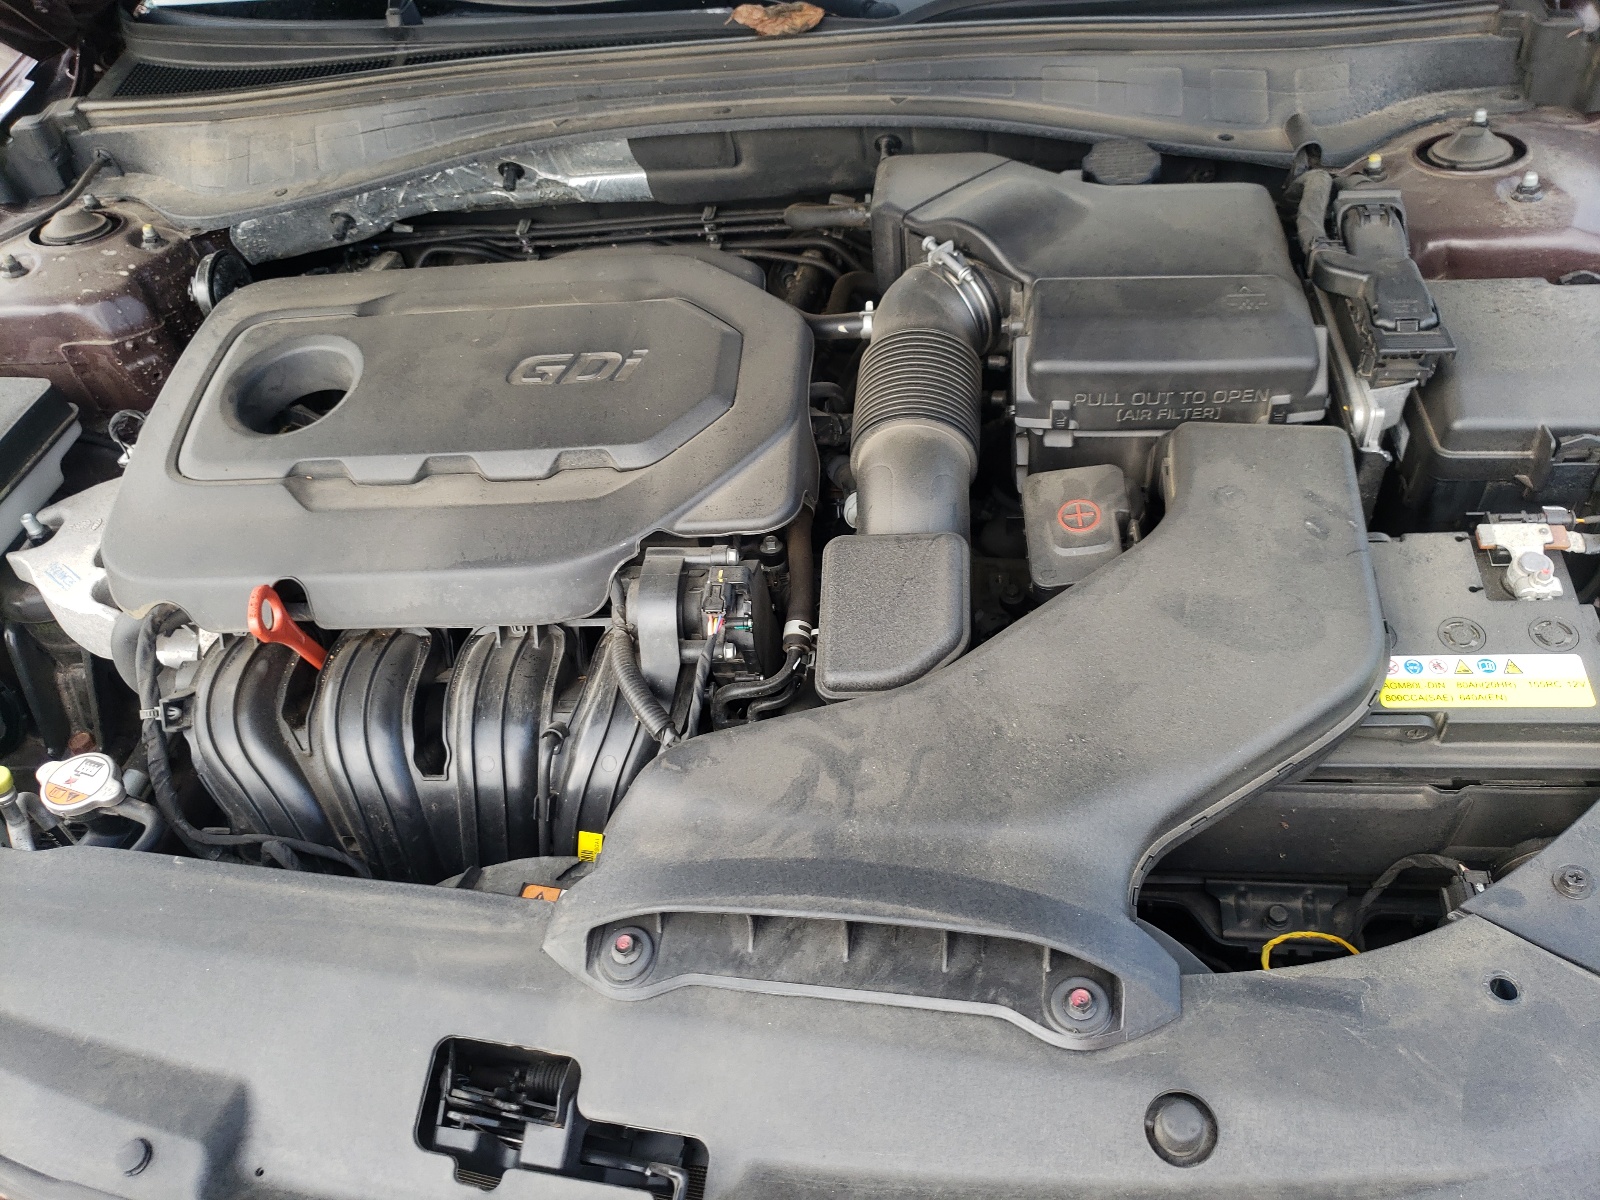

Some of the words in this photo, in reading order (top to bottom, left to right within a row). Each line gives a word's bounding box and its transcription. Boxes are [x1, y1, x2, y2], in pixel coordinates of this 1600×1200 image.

[506, 349, 649, 385] GDi
[1073, 393, 1125, 407] PULL
[1131, 391, 1174, 406] OUT
[1180, 390, 1206, 405] TO
[1211, 388, 1270, 404] OPEN
